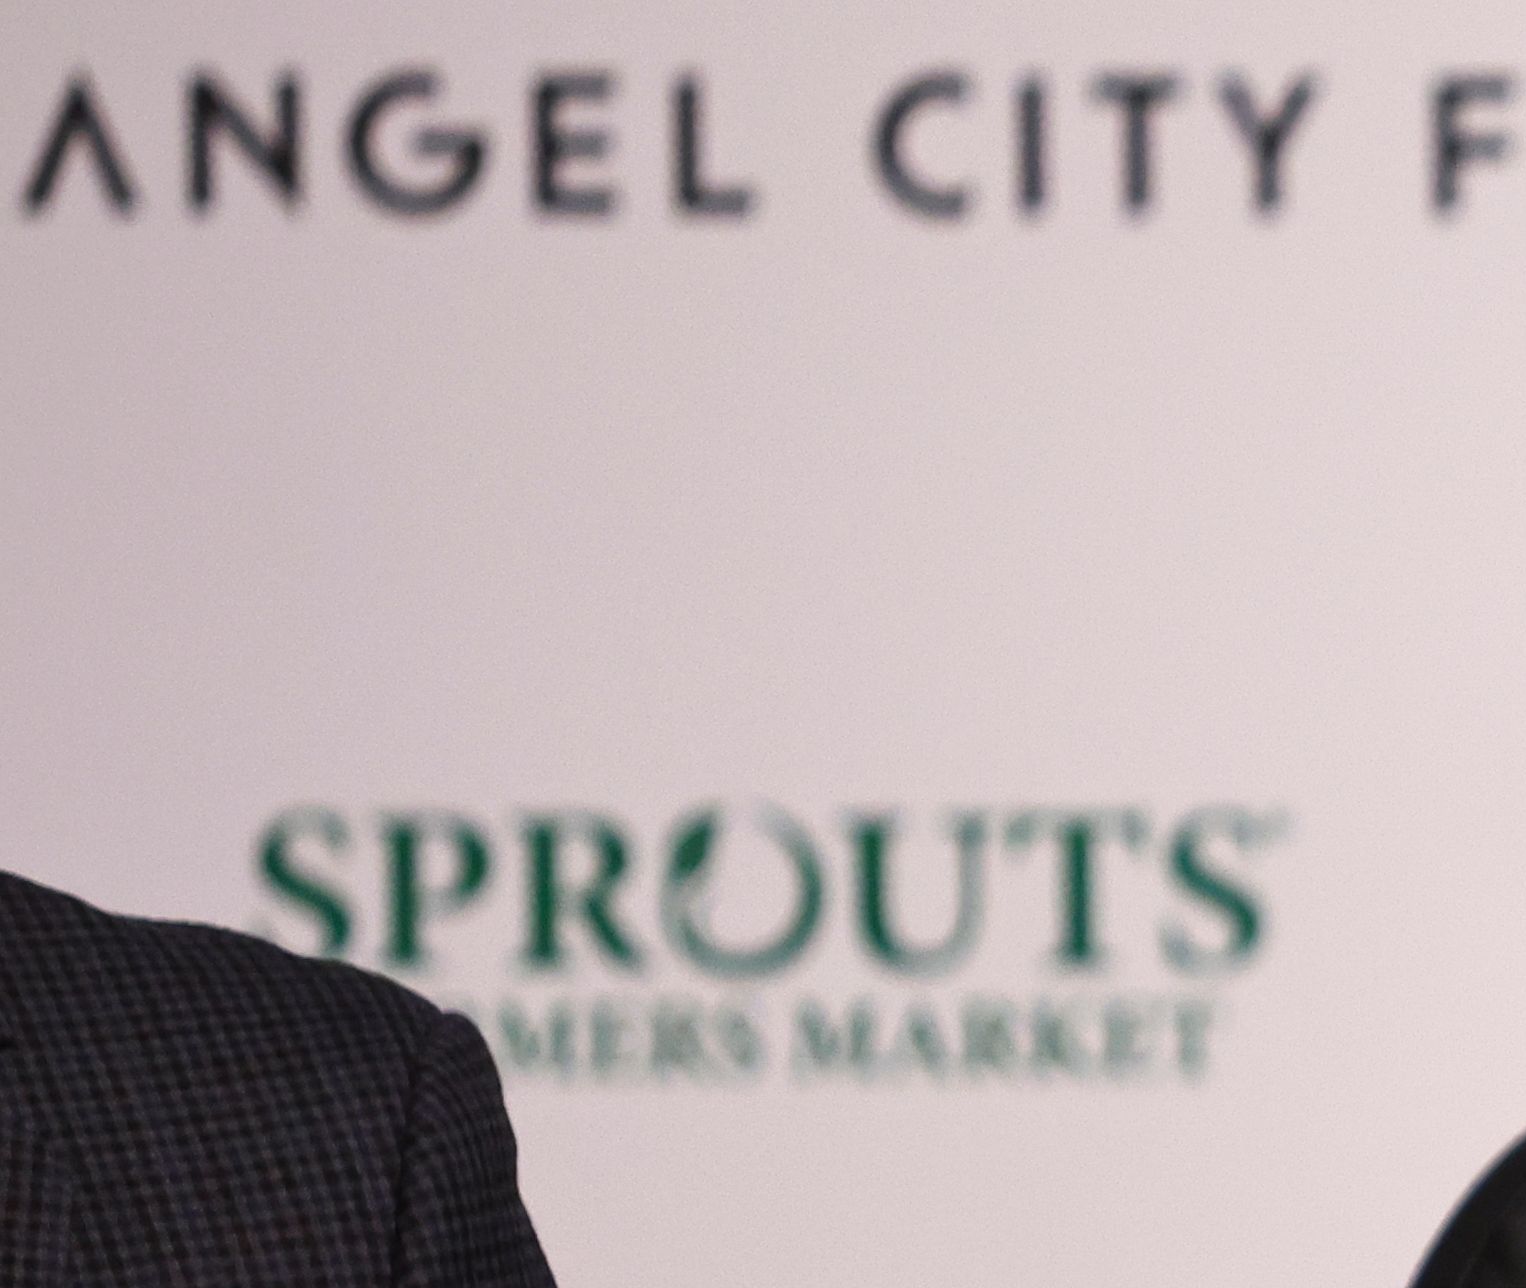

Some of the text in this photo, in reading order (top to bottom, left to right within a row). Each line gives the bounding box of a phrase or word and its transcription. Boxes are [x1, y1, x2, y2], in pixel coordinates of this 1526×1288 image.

[20, 68, 755, 222] ANGEL
[868, 68, 1320, 223] CITY
[252, 806, 1270, 978] SPROUTS
[791, 996, 1214, 1084] MARKET
